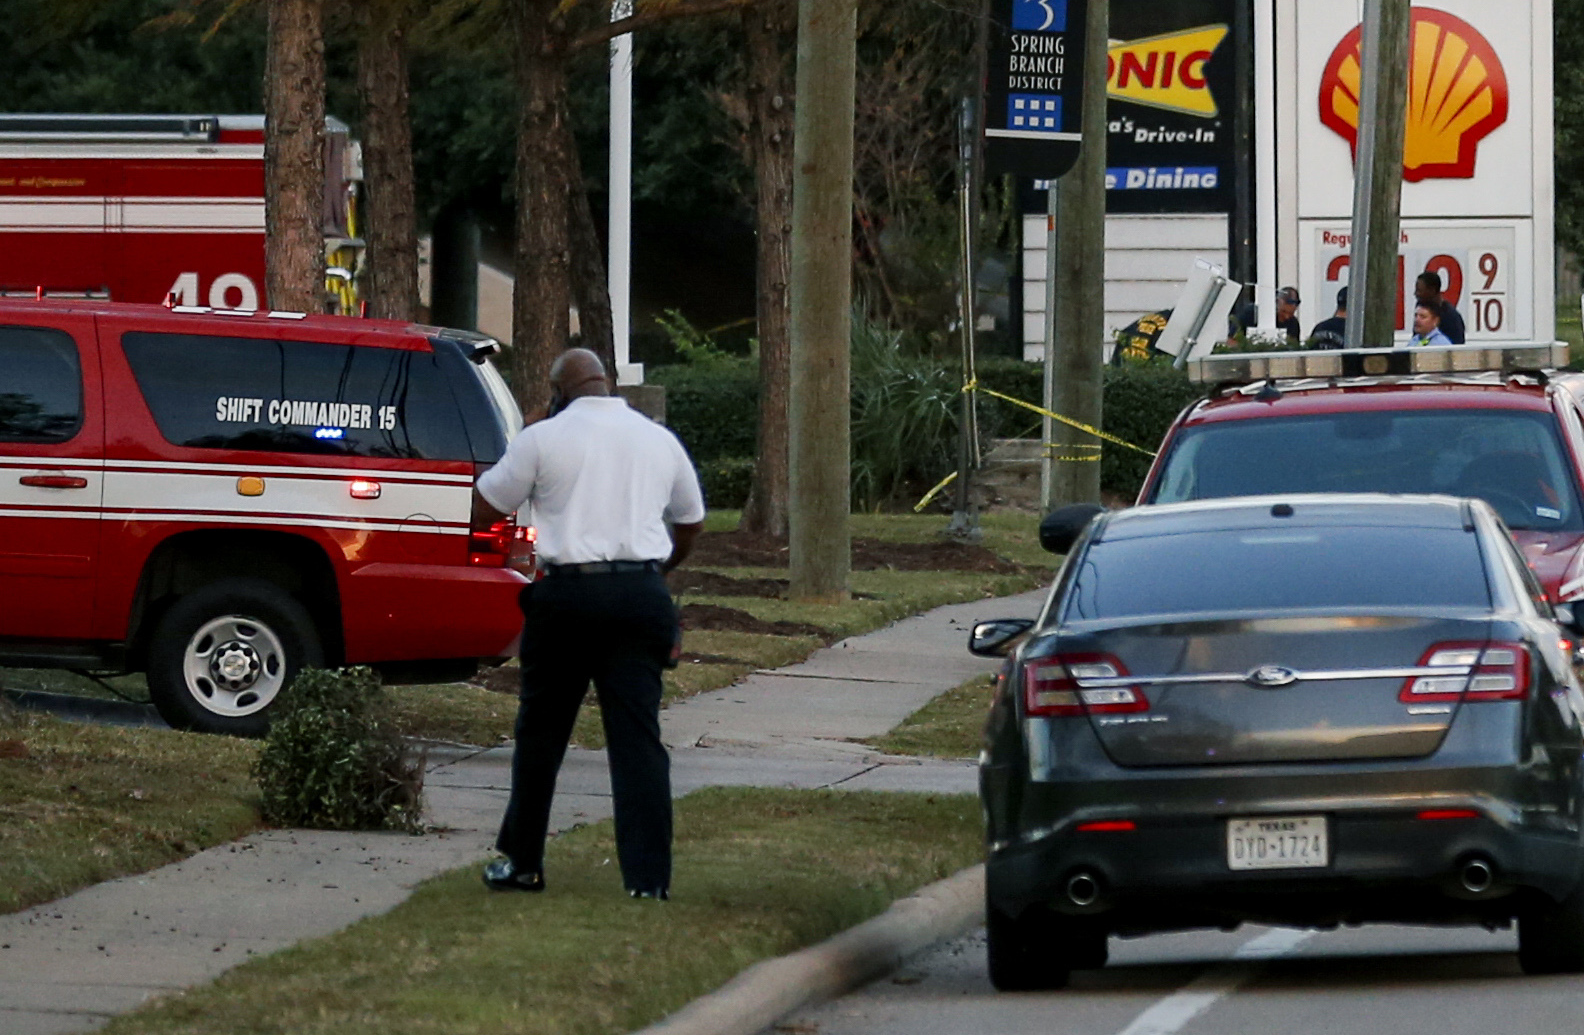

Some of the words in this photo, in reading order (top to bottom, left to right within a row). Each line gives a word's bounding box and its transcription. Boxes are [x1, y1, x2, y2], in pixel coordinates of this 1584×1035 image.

[1011, 34, 1064, 55] SPRING
[1009, 55, 1064, 74] BRANCH
[1008, 76, 1063, 90] DISTRICT
[1478, 252, 1499, 291] 9
[1473, 298, 1504, 333] 10
[216, 396, 263, 423] SHIFT
[268, 399, 372, 429] COMMANDER
[378, 405, 397, 430] 15
